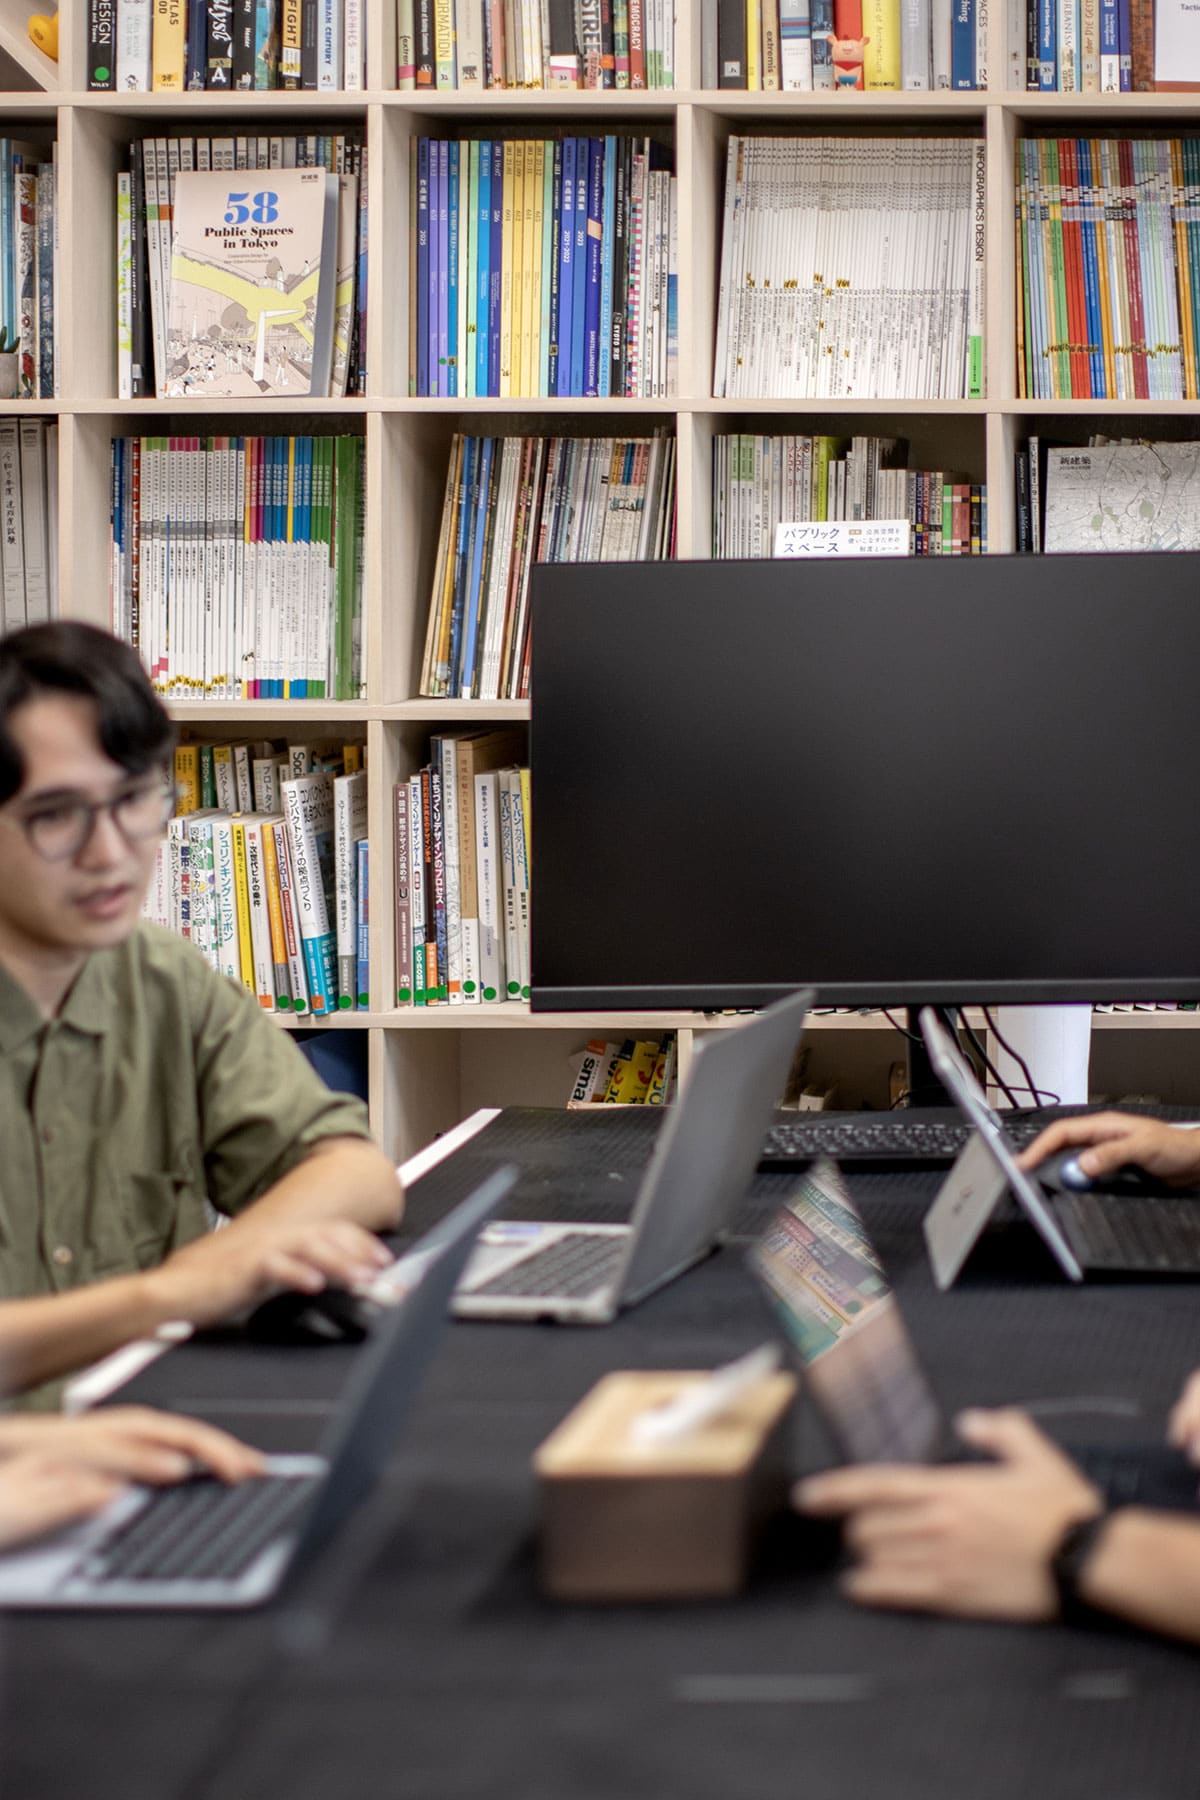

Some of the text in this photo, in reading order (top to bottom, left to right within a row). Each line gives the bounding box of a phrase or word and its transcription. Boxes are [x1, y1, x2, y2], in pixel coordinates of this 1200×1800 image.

[98, 0, 111, 44] ESIGN
[224, 191, 279, 224] 58
[975, 146, 985, 262] INFOGRAPHICS DESIGN
[204, 225, 294, 238] Public Spaces
[223, 238, 279, 250] in Tokyo
[1060, 456, 1092, 465] 新建築
[783, 527, 840, 540] パブリック
[783, 542, 840, 553] スペース
[287, 790, 312, 911] コンパクトシティの拠点づくり
[431, 774, 446, 905] まちづくりデザインのプロセス
[218, 829, 234, 942] シュリンキング・ニッポン
